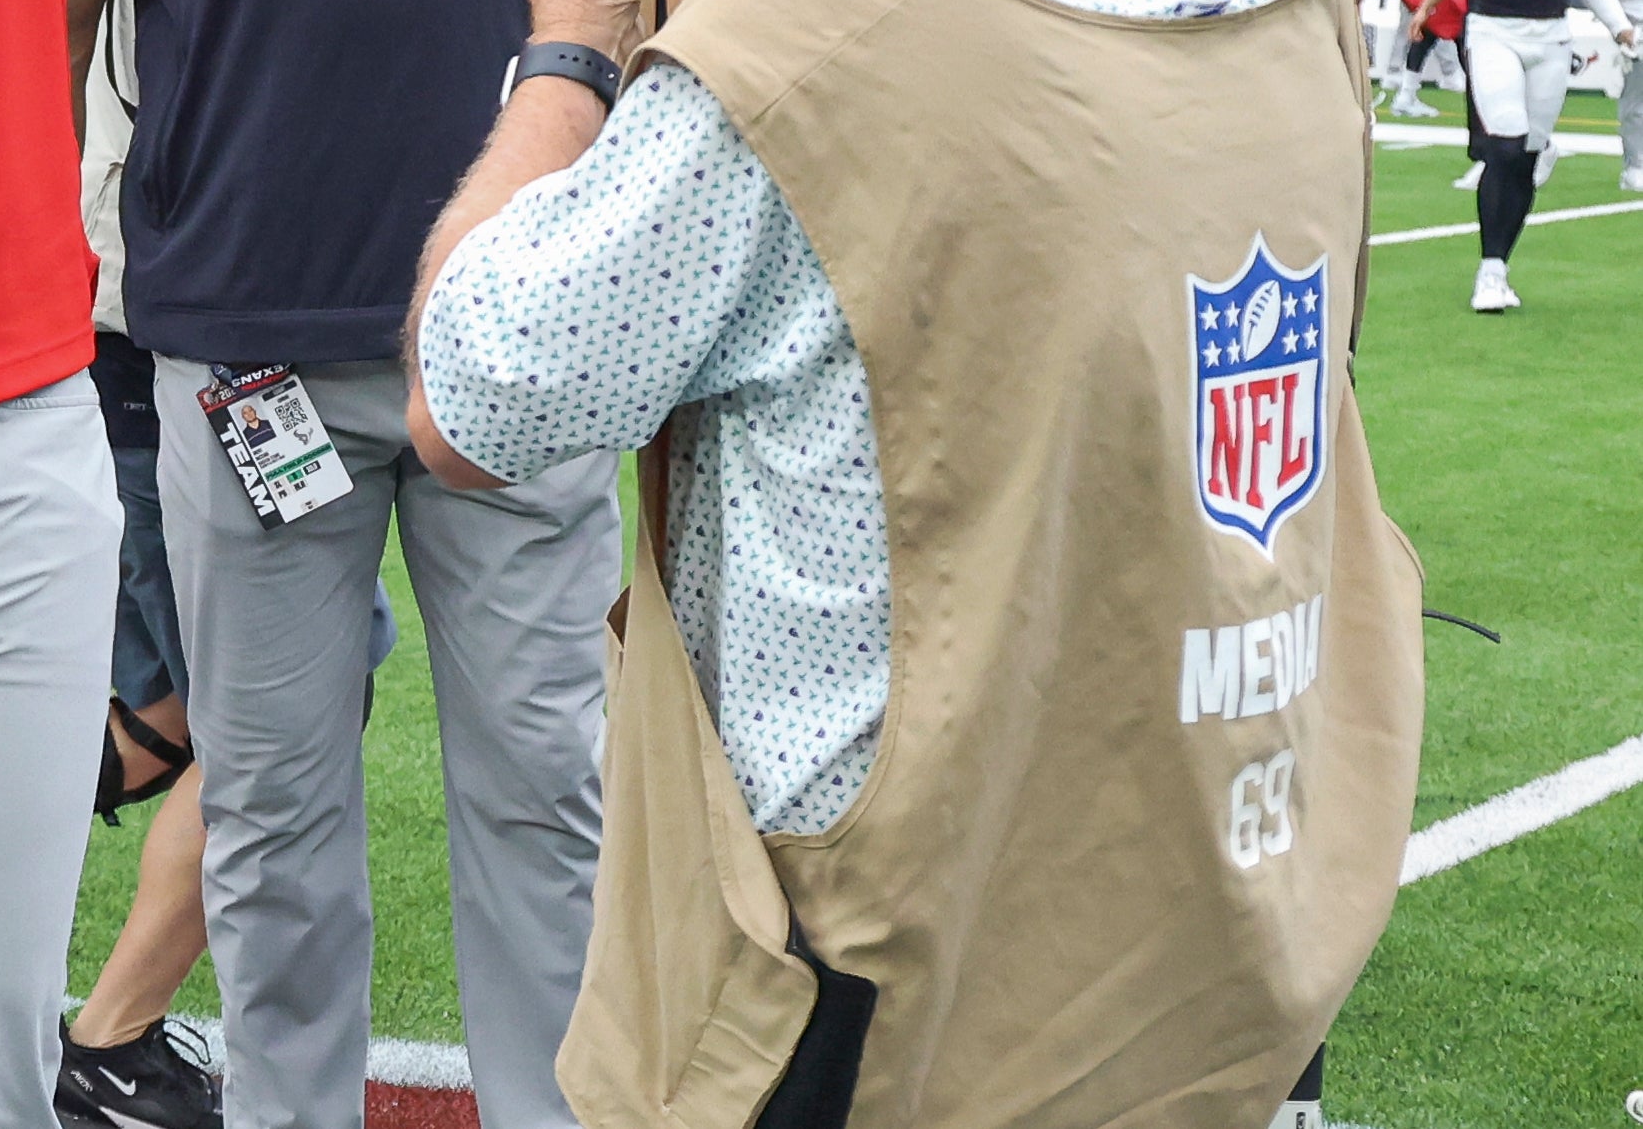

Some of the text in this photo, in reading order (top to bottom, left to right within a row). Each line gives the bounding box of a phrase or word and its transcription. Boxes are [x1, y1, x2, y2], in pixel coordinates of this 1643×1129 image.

[219, 422, 277, 517] TEAM
[1208, 373, 1307, 510] NFL
[1181, 593, 1323, 724] MEDIA
[1230, 748, 1295, 869] 69
